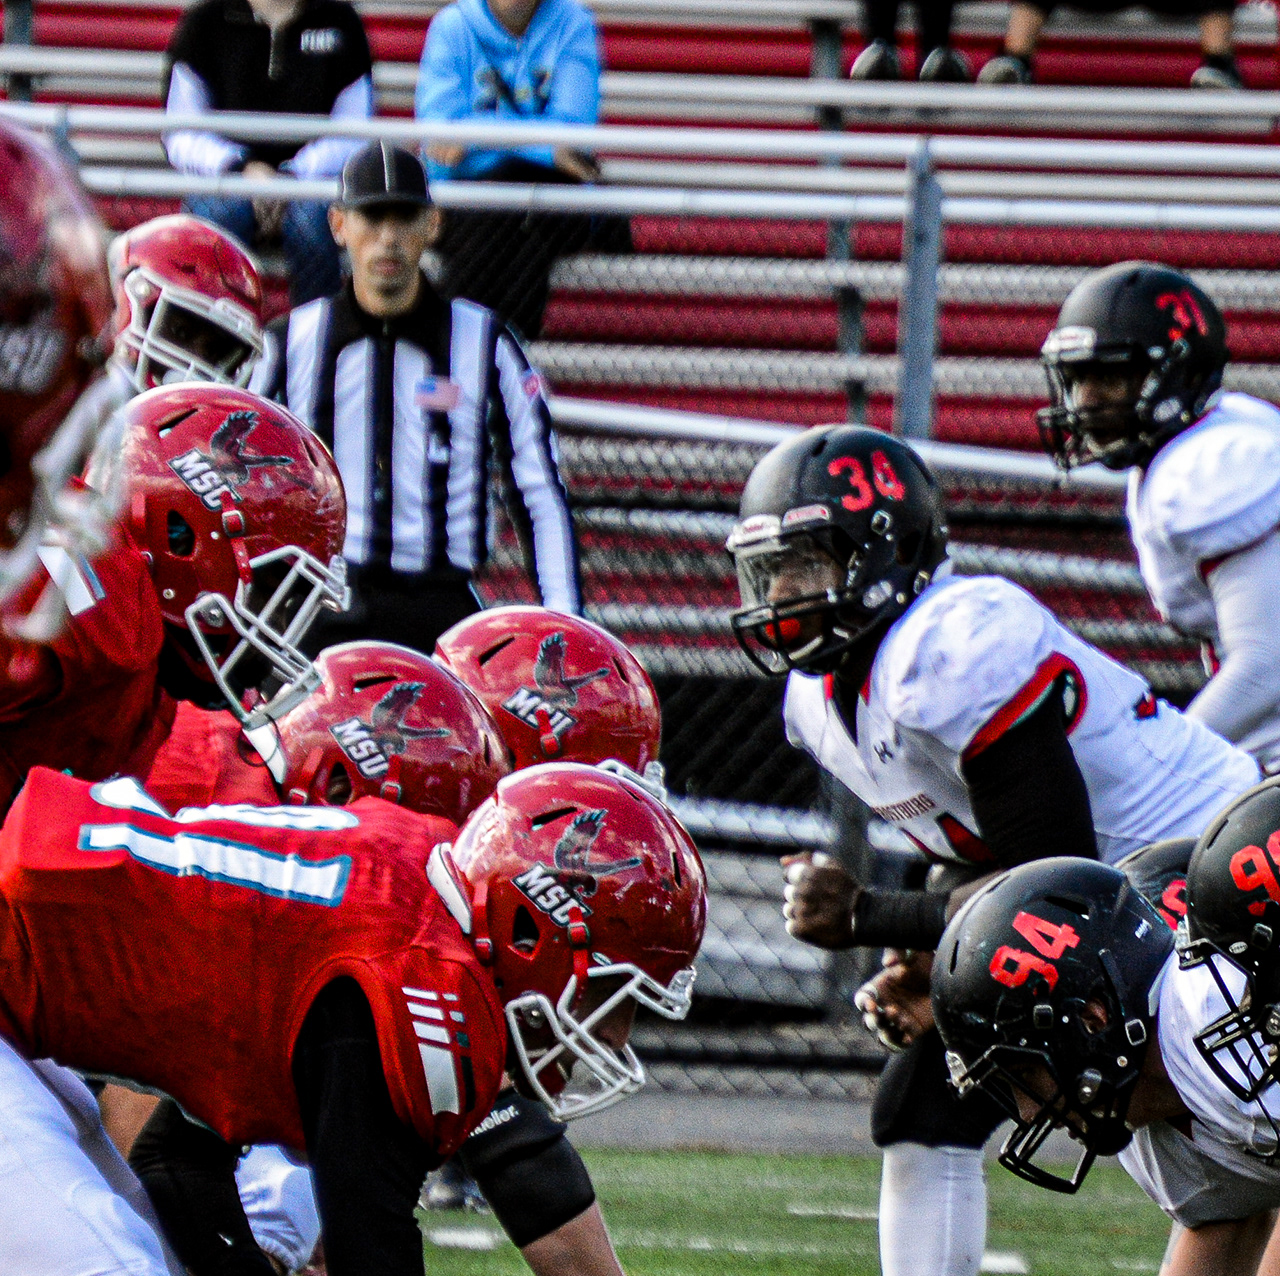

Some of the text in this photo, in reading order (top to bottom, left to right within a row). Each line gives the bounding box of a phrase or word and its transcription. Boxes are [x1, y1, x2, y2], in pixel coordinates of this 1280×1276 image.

[172, 450, 239, 508] MSU
[827, 450, 906, 512] 34
[332, 718, 390, 776] MSU
[515, 865, 589, 923] MSU
[988, 911, 1080, 997] 94
